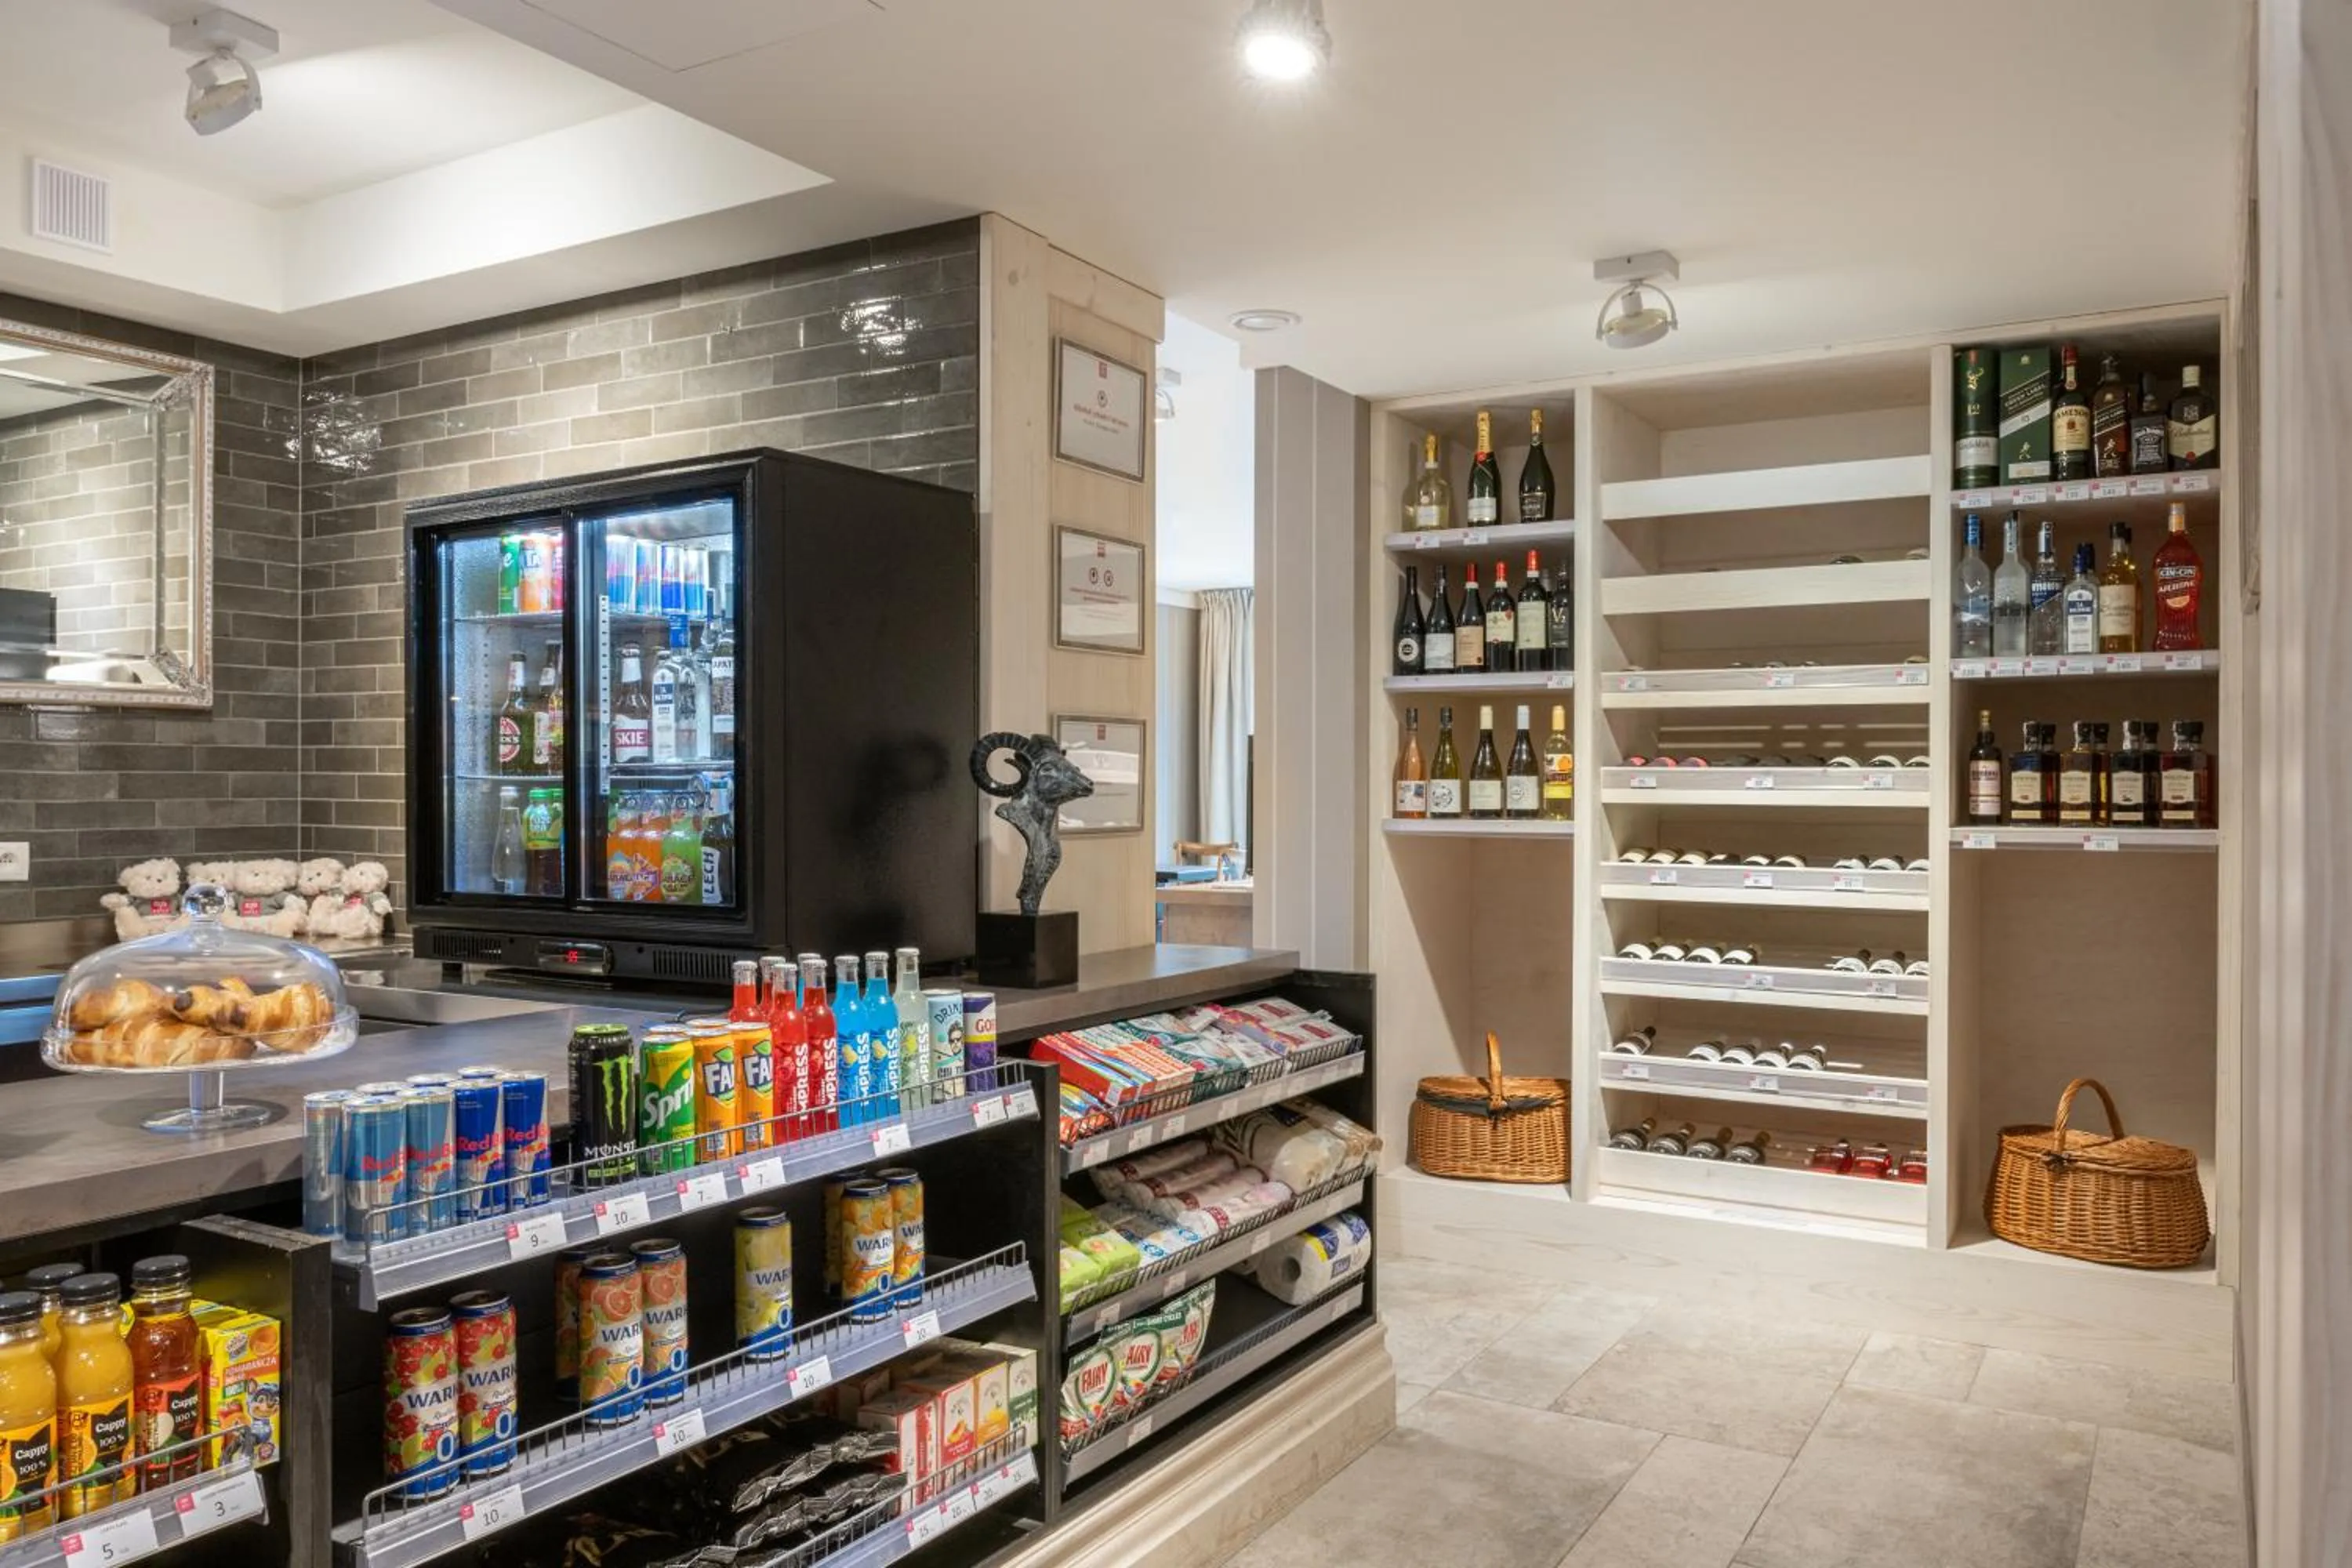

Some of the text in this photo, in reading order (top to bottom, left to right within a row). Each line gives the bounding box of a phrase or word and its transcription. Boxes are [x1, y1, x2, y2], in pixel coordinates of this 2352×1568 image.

[704, 851, 714, 895] LECH
[744, 1056, 773, 1087] FA
[857, 1032, 869, 1107] IMPRESS
[886, 1027, 898, 1100] IMPRESS
[796, 1043, 809, 1121] IMPRESS
[824, 1037, 837, 1114] IMPRESS
[504, 1123, 535, 1142] Red
[456, 1133, 490, 1152] Red
[615, 1211, 628, 1227] 10
[531, 1233, 539, 1247] 9
[856, 1235, 892, 1252] WAR
[804, 1374, 815, 1388] 10
[95, 1417, 125, 1433] Cappy
[100, 1436, 116, 1447] 100
[672, 1429, 686, 1445] 10
[16, 1443, 48, 1460] Cappy
[20, 1464, 38, 1475] 100
[214, 1501, 226, 1517] 3
[483, 1509, 499, 1526] 10
[103, 1542, 114, 1560] 5
